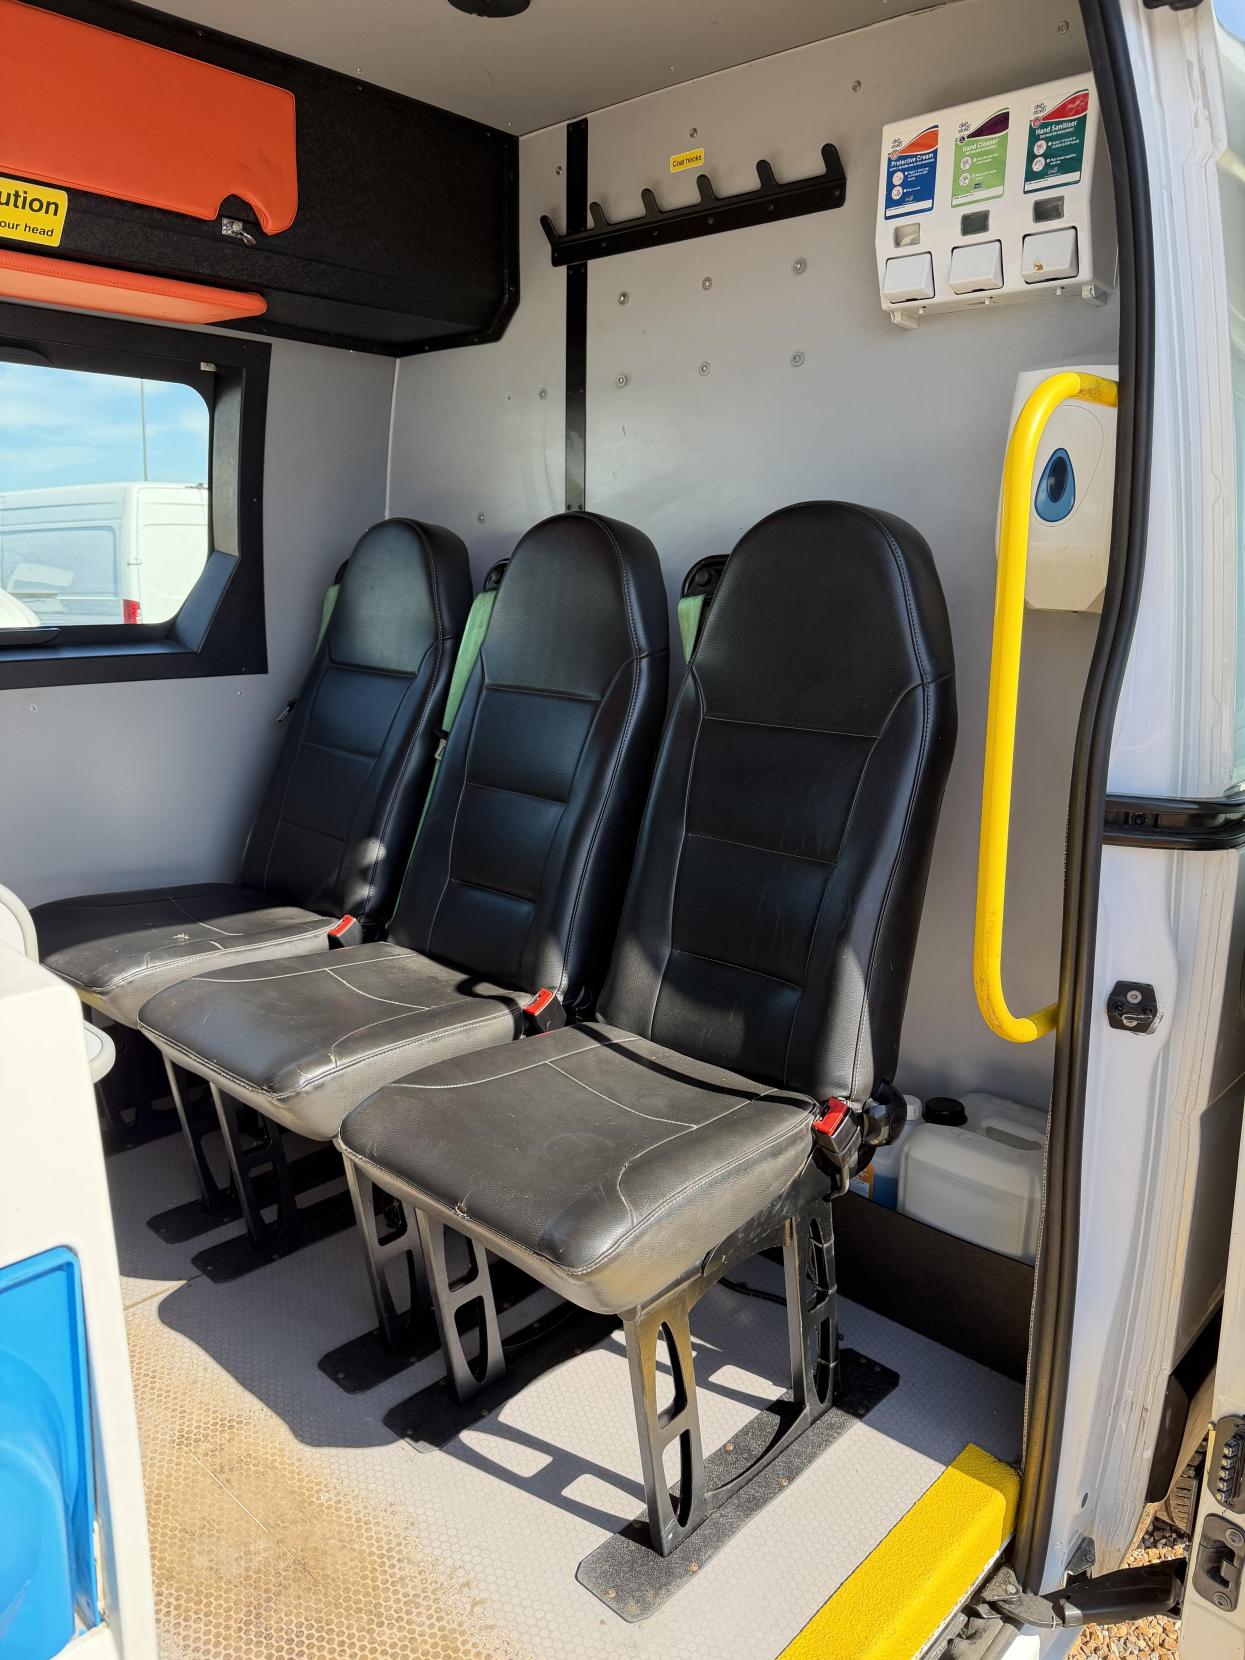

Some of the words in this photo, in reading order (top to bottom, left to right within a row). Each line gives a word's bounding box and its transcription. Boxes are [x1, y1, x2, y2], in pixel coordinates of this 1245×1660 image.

[1035, 126, 1051, 135] Hand
[1051, 120, 1078, 132] Sanitiser
[962, 142, 977, 152] Hand
[977, 137, 1000, 150] Cleaner
[672, 160, 685, 168] Coat
[685, 154, 702, 163] hooks
[891, 157, 917, 168] Protective
[917, 153, 934, 162] Cream
[23, 223, 55, 237] head
